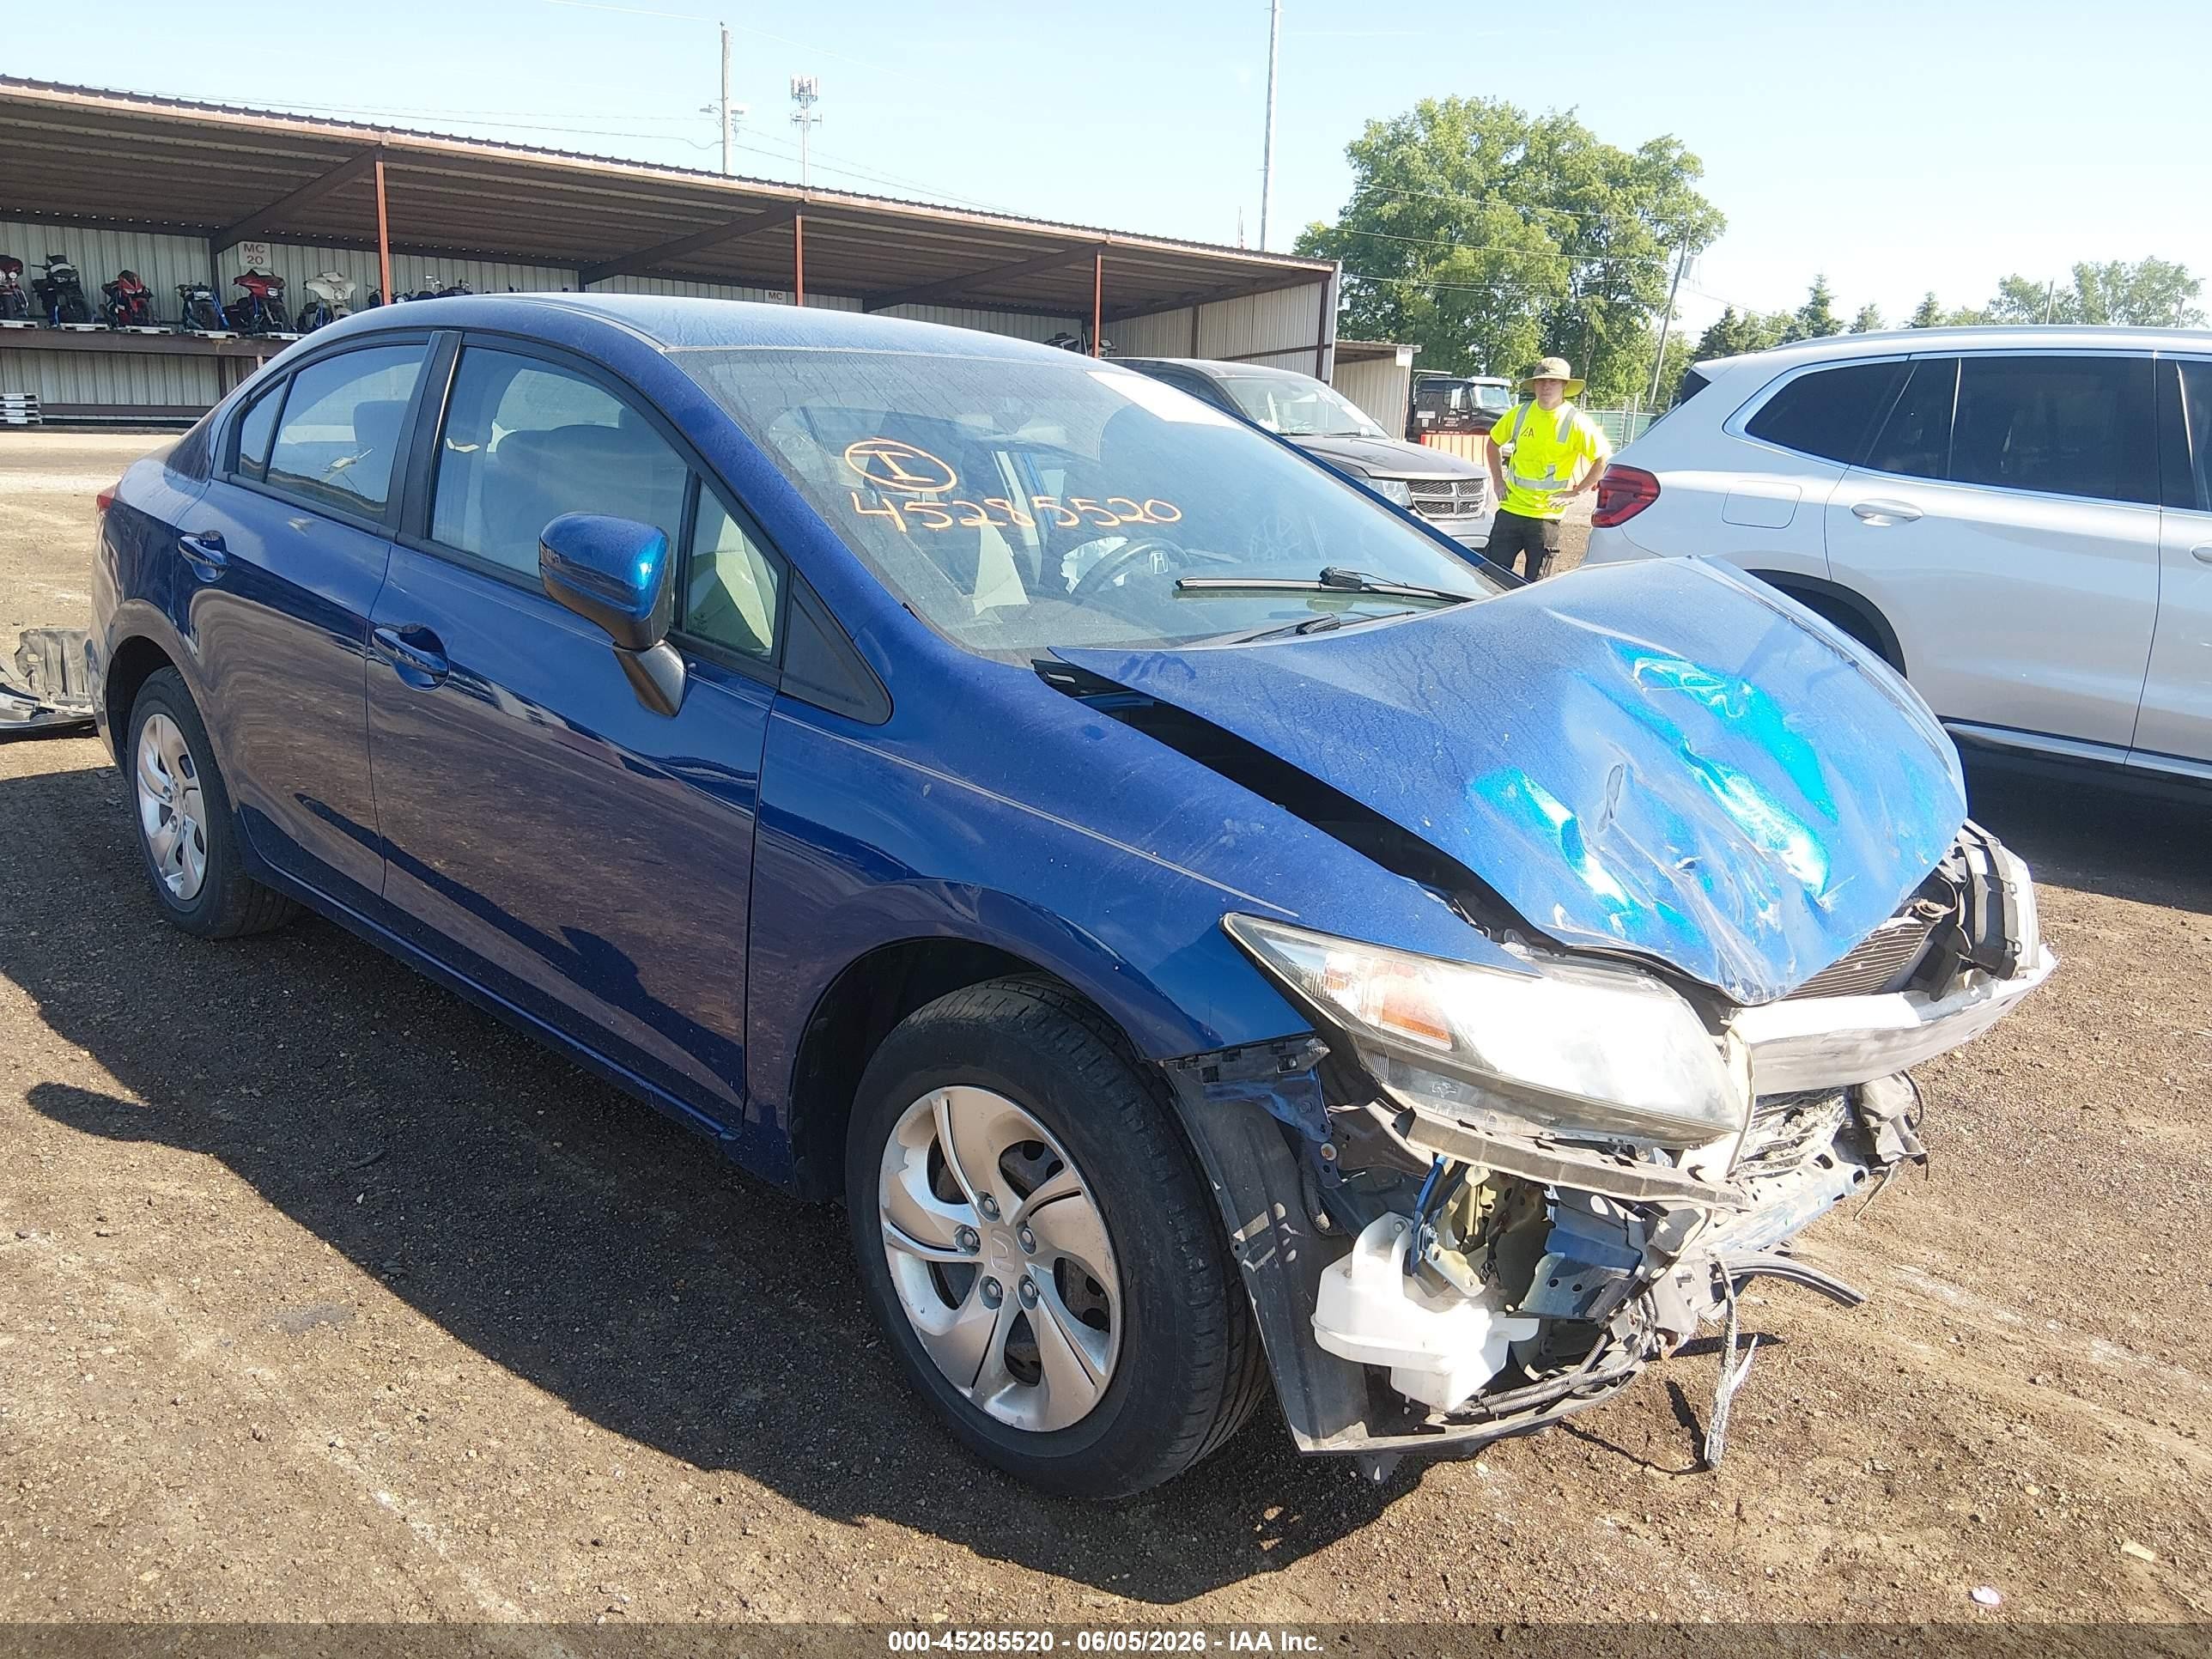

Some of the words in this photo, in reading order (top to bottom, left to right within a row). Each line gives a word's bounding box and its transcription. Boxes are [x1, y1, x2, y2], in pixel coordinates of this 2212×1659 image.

[243, 243, 265, 254] MC
[246, 255, 264, 265] 20
[769, 291, 783, 301] MC
[851, 491, 1182, 533] 45285520
